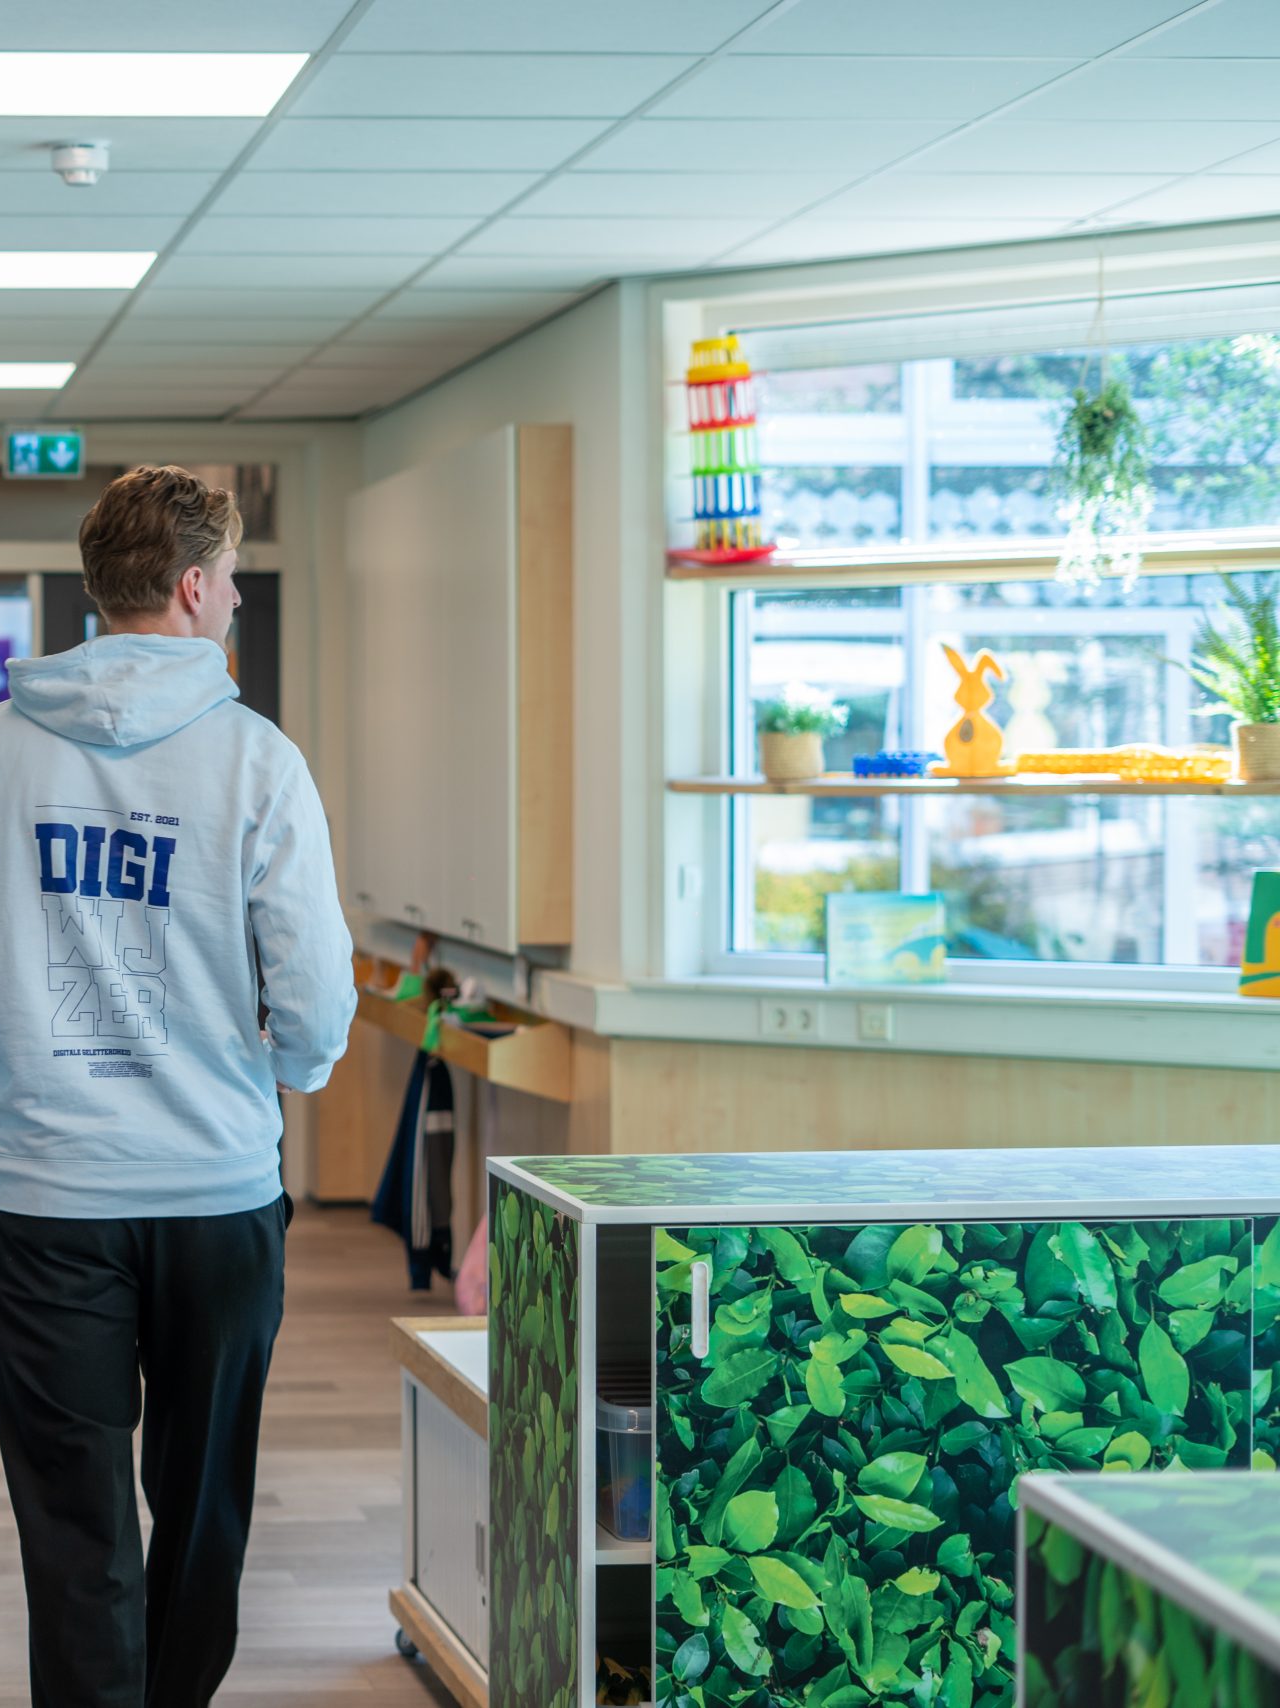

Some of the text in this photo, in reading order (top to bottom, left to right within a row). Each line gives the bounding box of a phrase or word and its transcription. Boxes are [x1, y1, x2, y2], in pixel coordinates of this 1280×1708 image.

[130, 811, 180, 826] EST. 2021
[35, 823, 176, 907] DIGI
[41, 894, 170, 975] WIJ
[47, 966, 168, 1044] ZER
